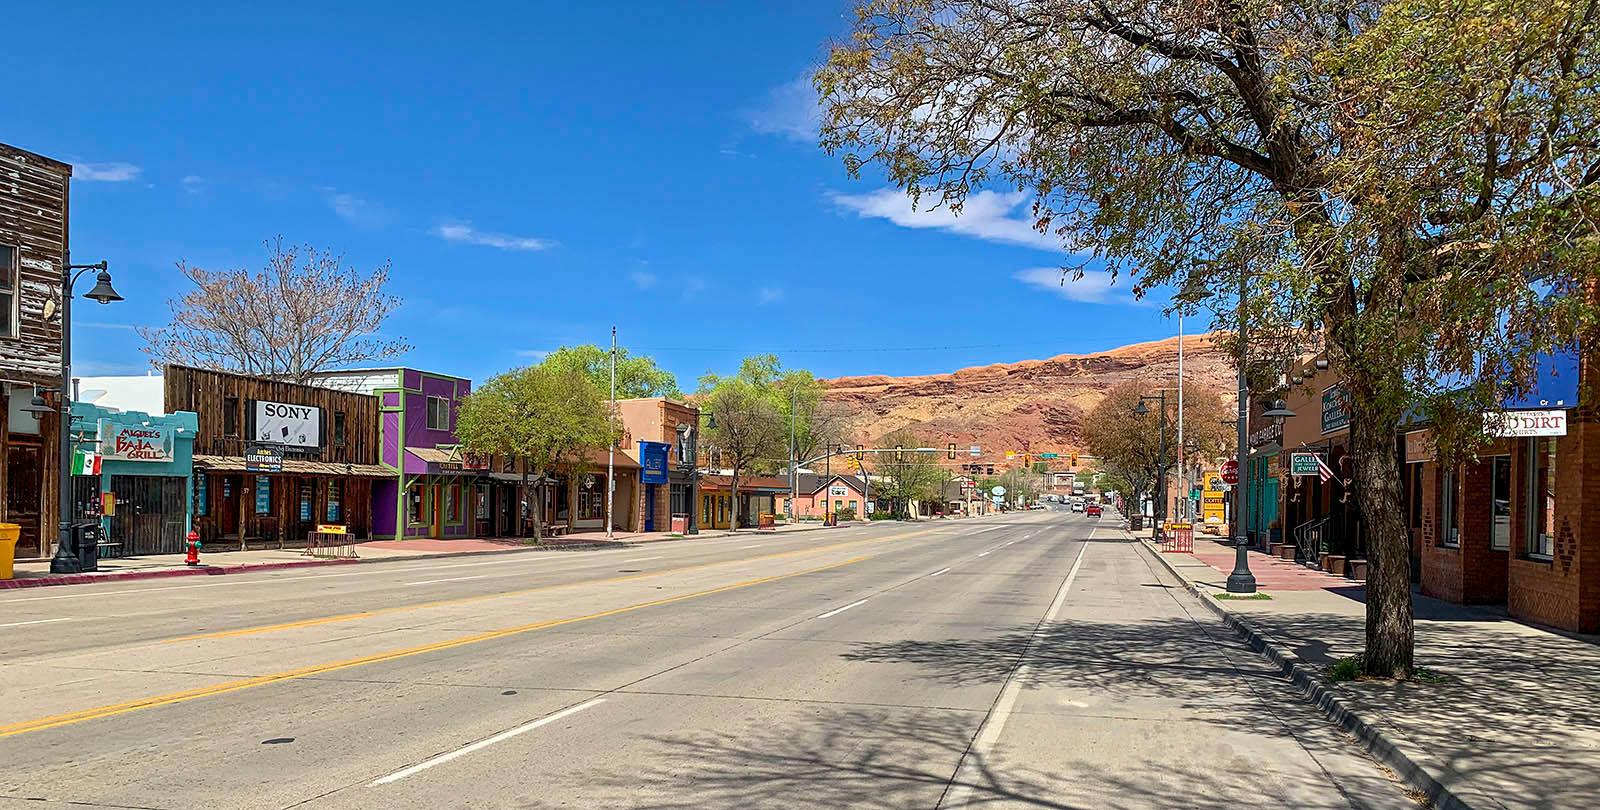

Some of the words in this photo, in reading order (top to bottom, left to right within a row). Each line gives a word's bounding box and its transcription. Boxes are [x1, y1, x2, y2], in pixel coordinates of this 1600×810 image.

[265, 403, 312, 420] SONY
[1523, 416, 1564, 429] DIRT
[120, 428, 161, 438] MIGUEL'S
[116, 436, 154, 453] BAJA
[127, 449, 165, 460] GRILL
[247, 454, 282, 464] ELECTRONICS
